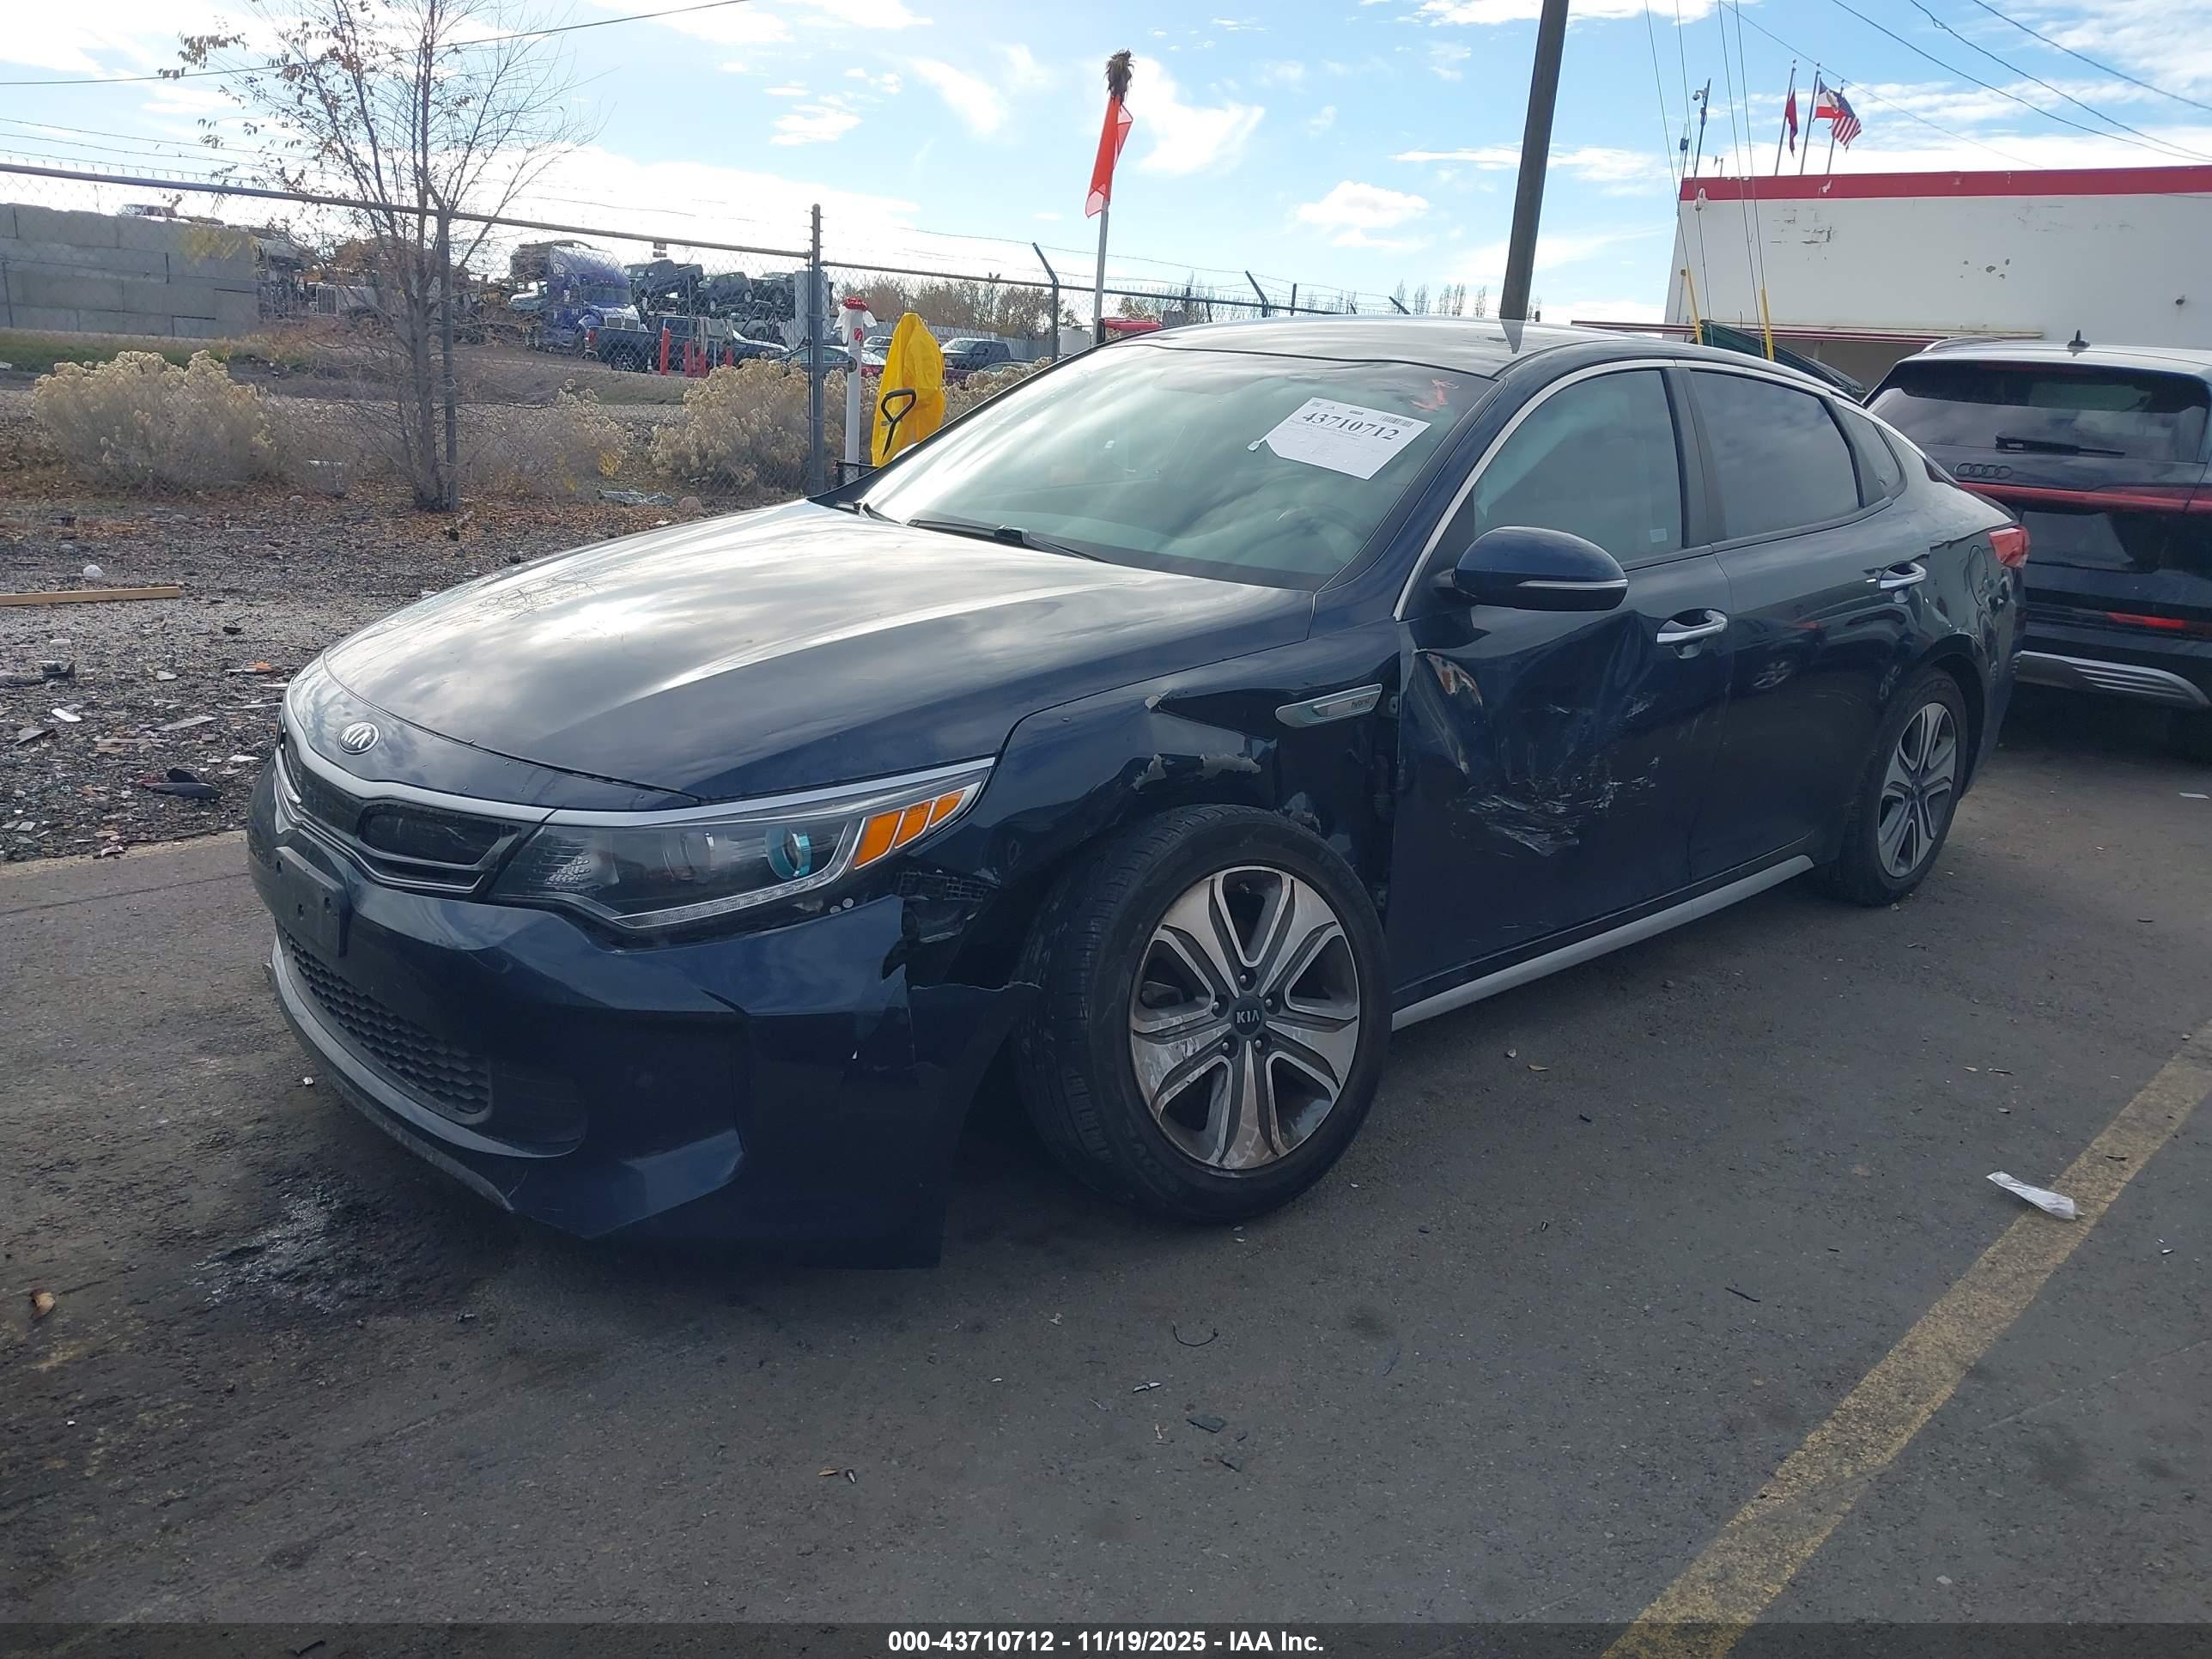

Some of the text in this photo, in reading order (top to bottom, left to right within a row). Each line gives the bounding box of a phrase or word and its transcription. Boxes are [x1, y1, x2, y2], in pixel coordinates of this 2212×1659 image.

[1302, 411, 1400, 441] 43710712
[340, 723, 374, 750] KIA
[1236, 1009, 1260, 1024] KIA
